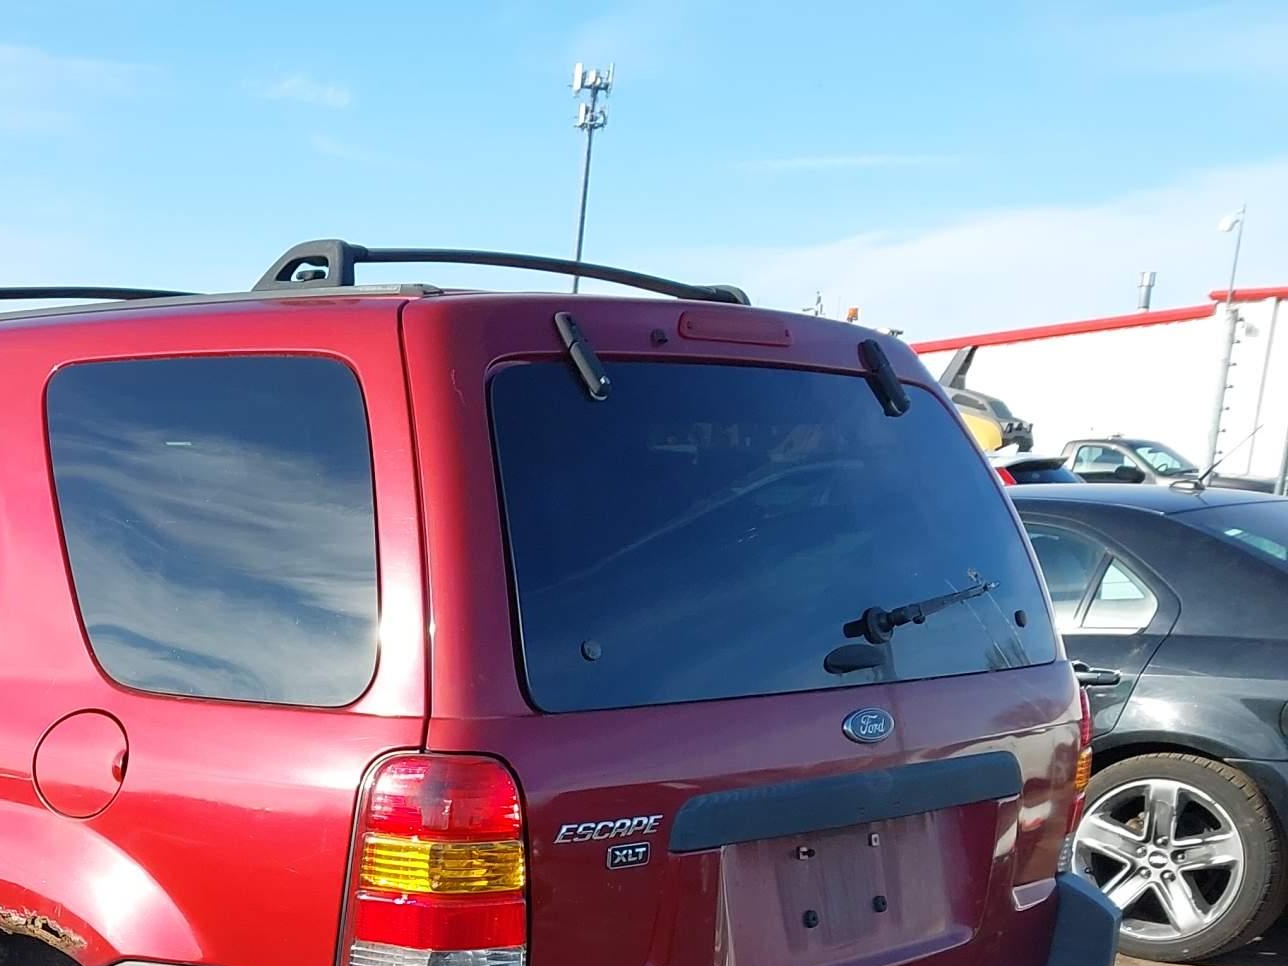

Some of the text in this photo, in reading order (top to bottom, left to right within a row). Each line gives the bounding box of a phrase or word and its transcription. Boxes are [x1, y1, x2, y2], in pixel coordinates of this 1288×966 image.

[859, 714, 886, 735] Ford
[554, 815, 663, 844] ESCAPE
[612, 848, 647, 865] XLT
